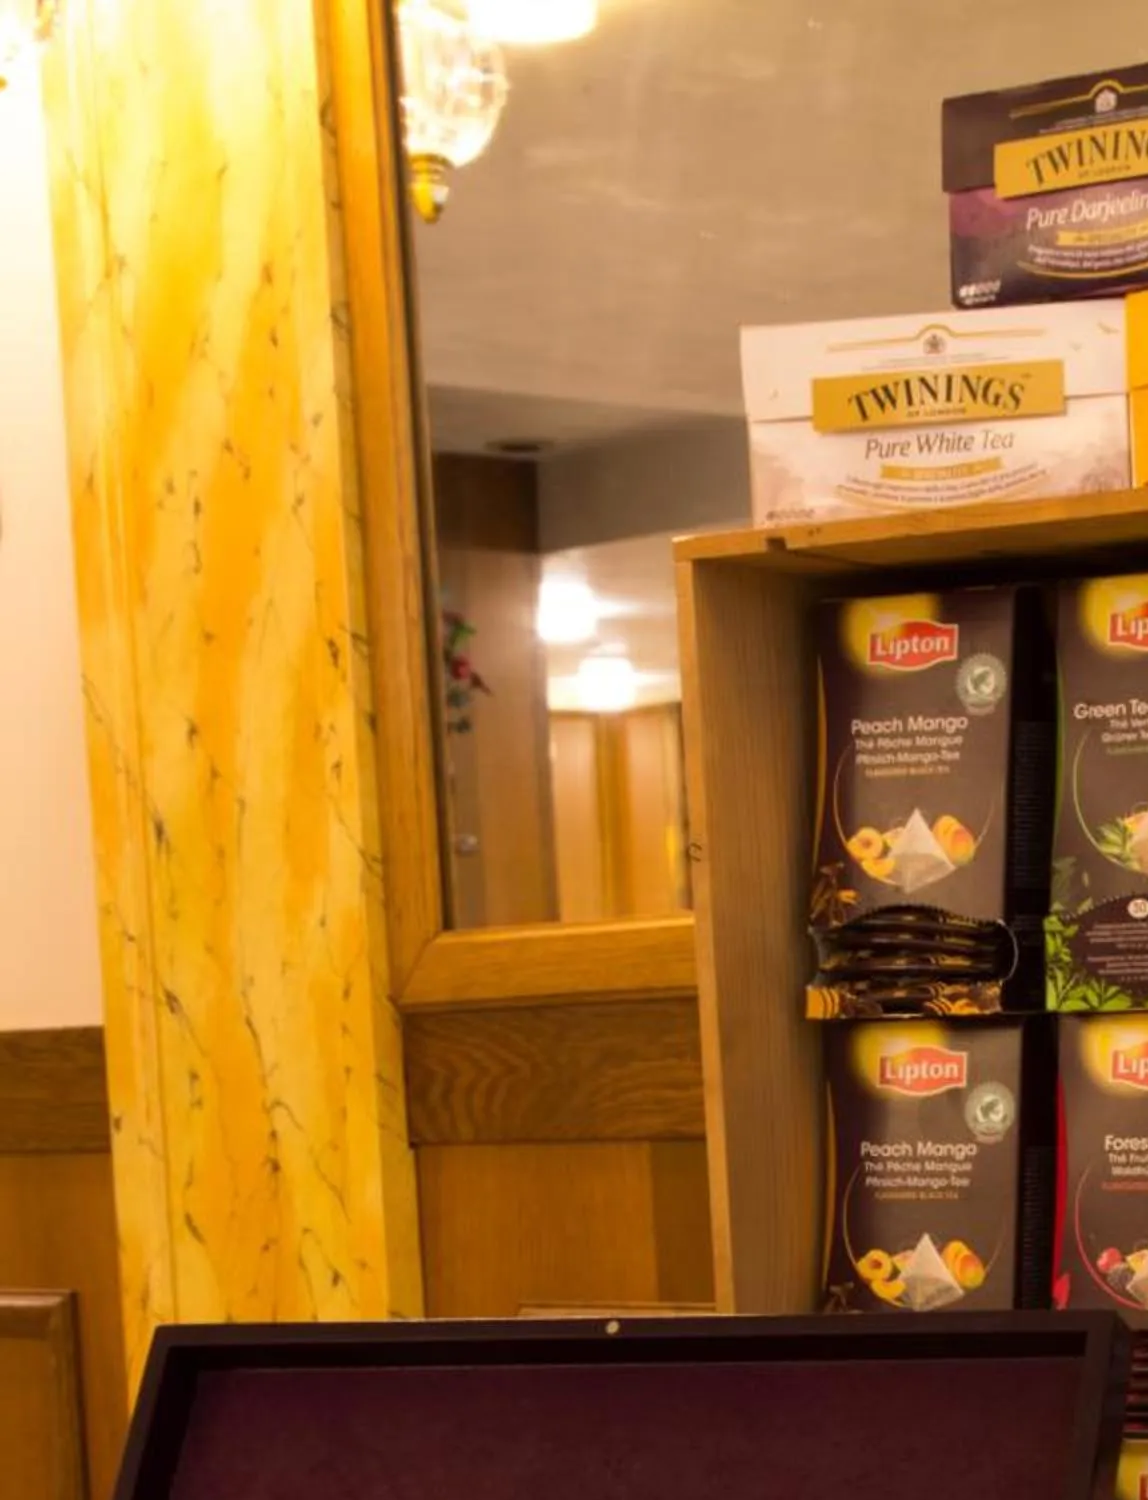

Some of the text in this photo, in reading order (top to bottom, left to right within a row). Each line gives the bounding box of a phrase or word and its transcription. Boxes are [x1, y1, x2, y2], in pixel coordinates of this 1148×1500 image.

[1026, 207, 1069, 231] Pure
[847, 373, 1025, 422] TWININGS
[865, 429, 1015, 460] Pure White Tea
[875, 635, 949, 660] Lipton
[1073, 703, 1127, 720] Green
[851, 716, 969, 735] Peach Mango
[885, 1059, 960, 1086] Lipton
[860, 1141, 978, 1161] Peach Mango
